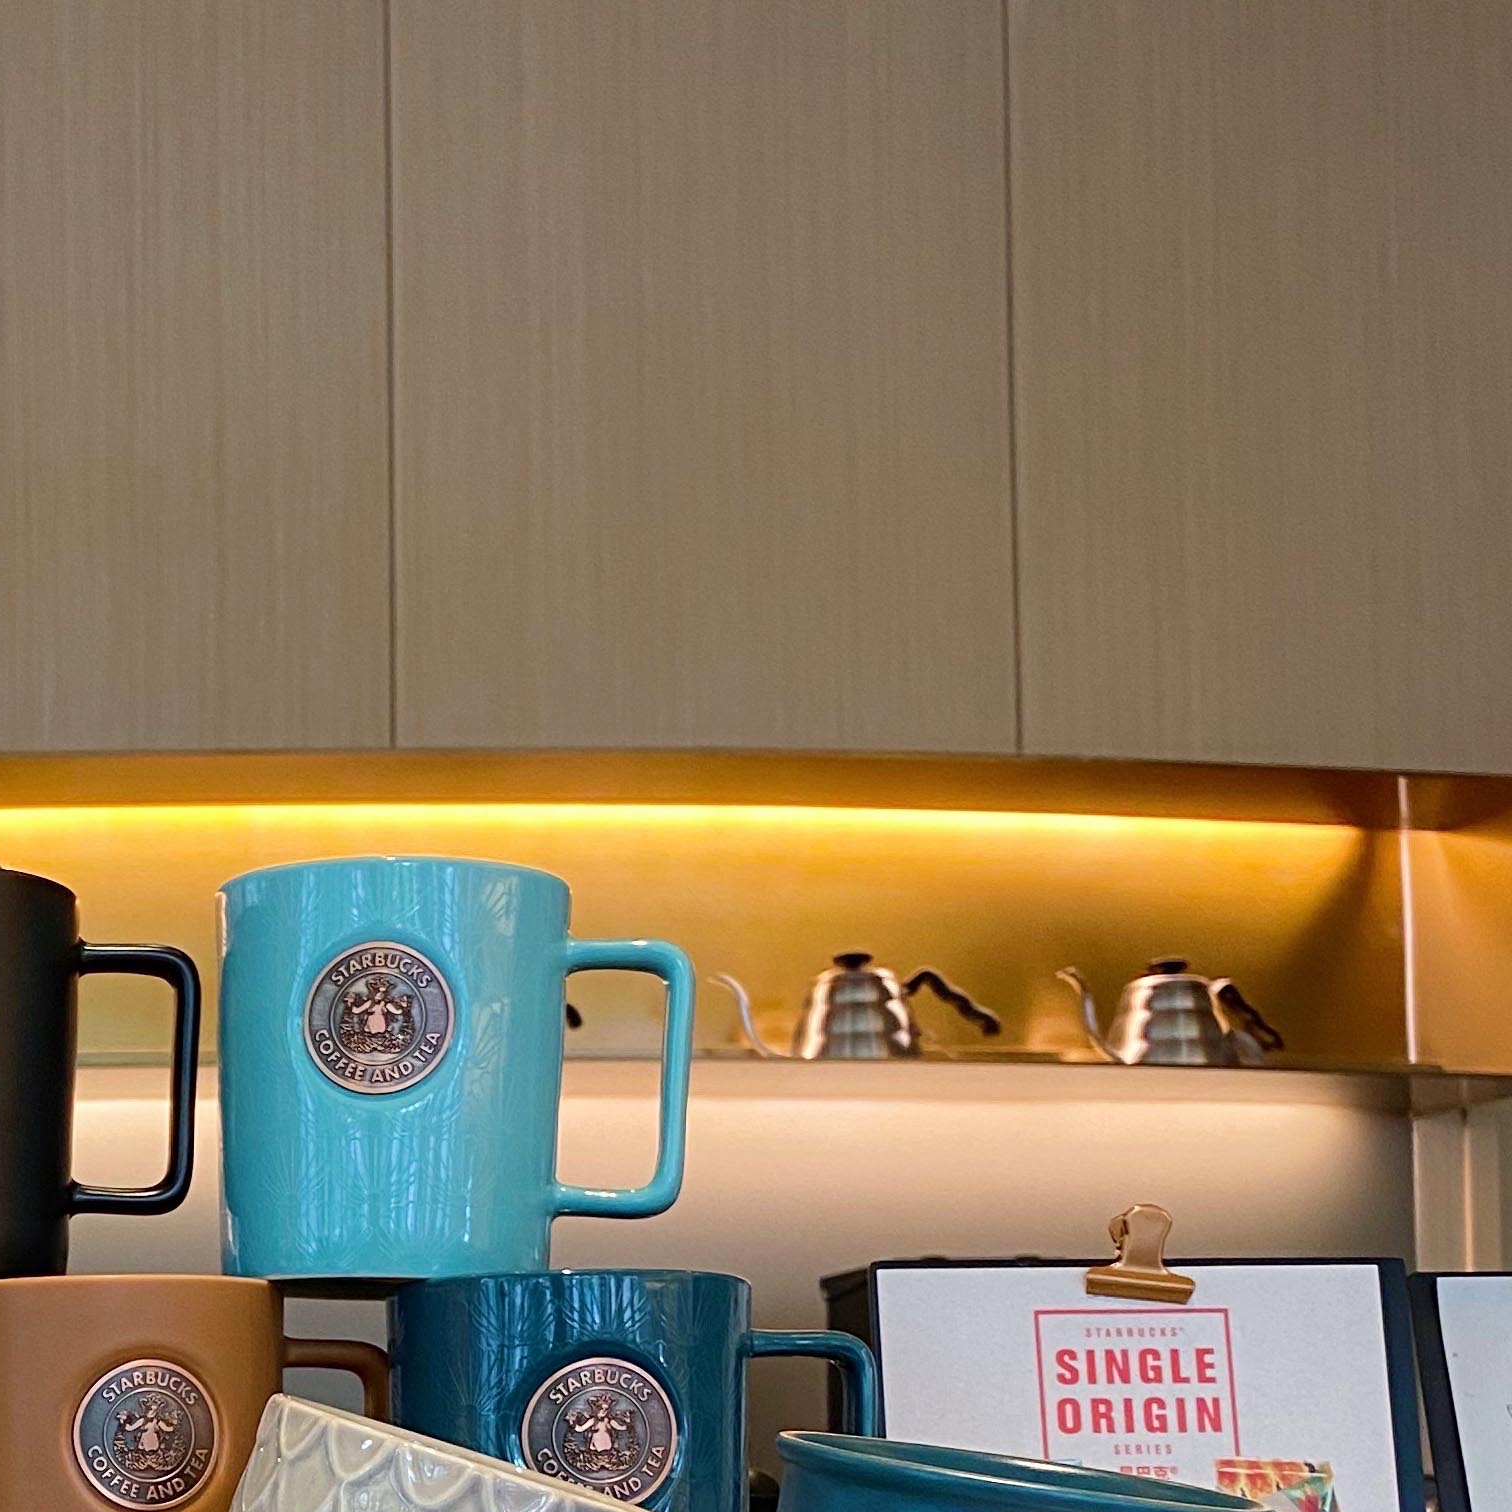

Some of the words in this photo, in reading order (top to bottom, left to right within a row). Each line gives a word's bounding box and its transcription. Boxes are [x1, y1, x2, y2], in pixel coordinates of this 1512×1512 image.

[330, 952, 433, 990] STARBUCKS
[314, 1030, 365, 1082] COFFEE
[371, 1059, 413, 1083] AND
[414, 1031, 441, 1064] TEA
[1055, 1348, 1217, 1385] SINGLE
[101, 1371, 200, 1406] STARBUCKS
[547, 1368, 653, 1404] STARBUCKS
[1057, 1397, 1223, 1434] ORIGIN
[640, 1445, 666, 1477] TEA
[1113, 1444, 1173, 1455] SERIES
[87, 1445, 139, 1498] COFFEE
[146, 1478, 185, 1501] AND
[184, 1448, 210, 1480] TEA
